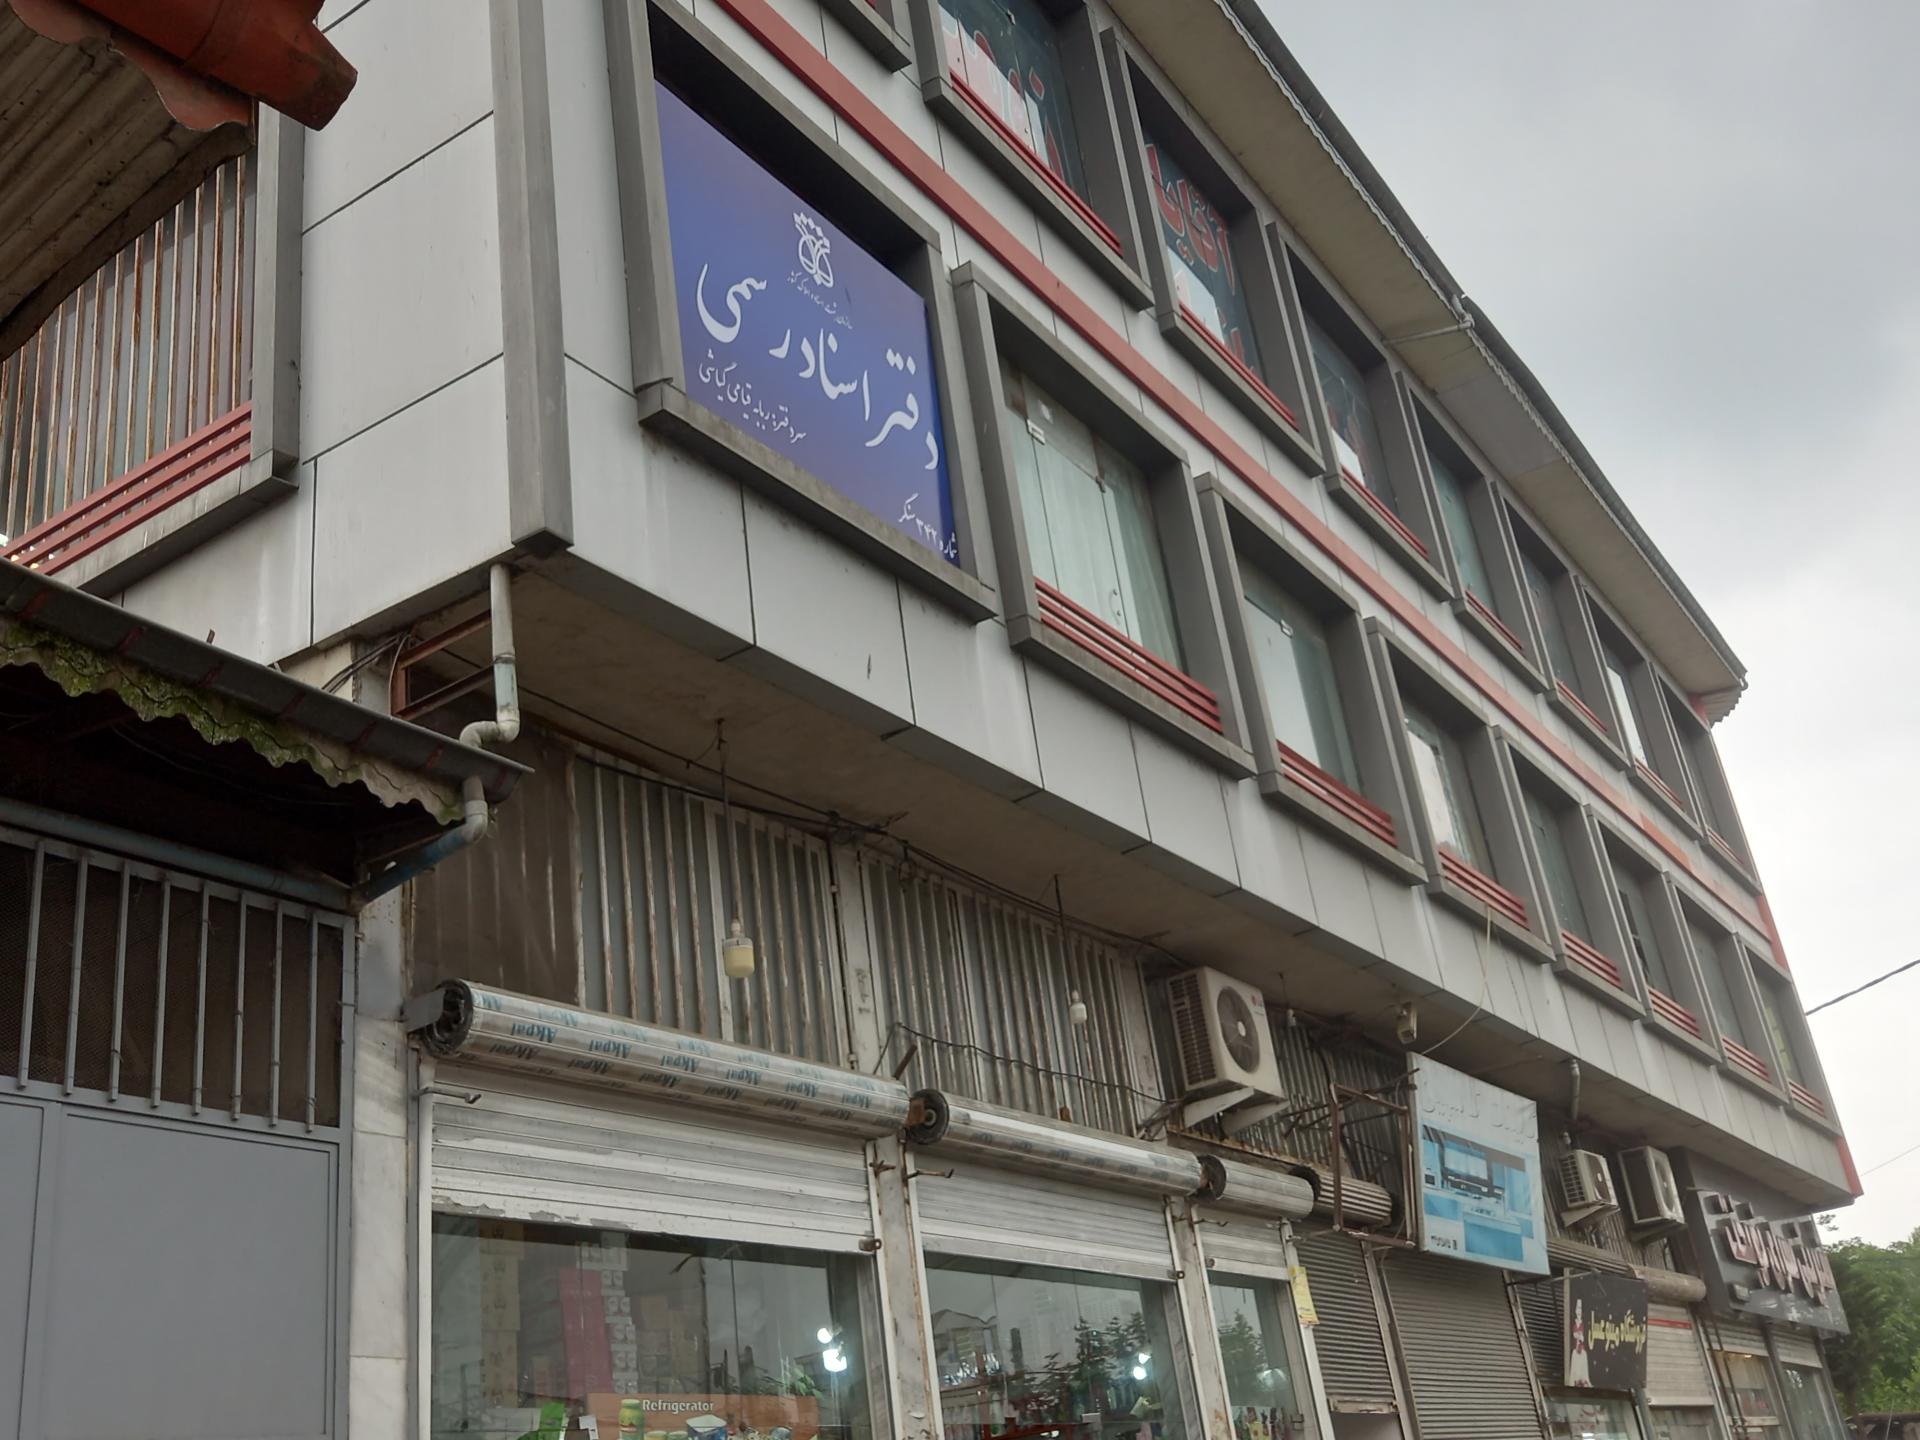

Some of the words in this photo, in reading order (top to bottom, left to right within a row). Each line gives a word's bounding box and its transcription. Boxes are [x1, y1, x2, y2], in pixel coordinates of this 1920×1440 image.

[696, 263, 791, 359] رسمی
[799, 328, 871, 422] اسناد
[865, 348, 939, 470] دفتر
[939, 532, 958, 559] شماره
[511, 1022, 559, 1043] Akpal
[589, 1039, 633, 1059] Akpal
[660, 1054, 700, 1073] Akpal
[727, 1068, 762, 1086] Akpal
[785, 1081, 819, 1098] Akpal
[1620, 1309, 1647, 1354] فروشگاه
[642, 1399, 714, 1415] Refrigerator
